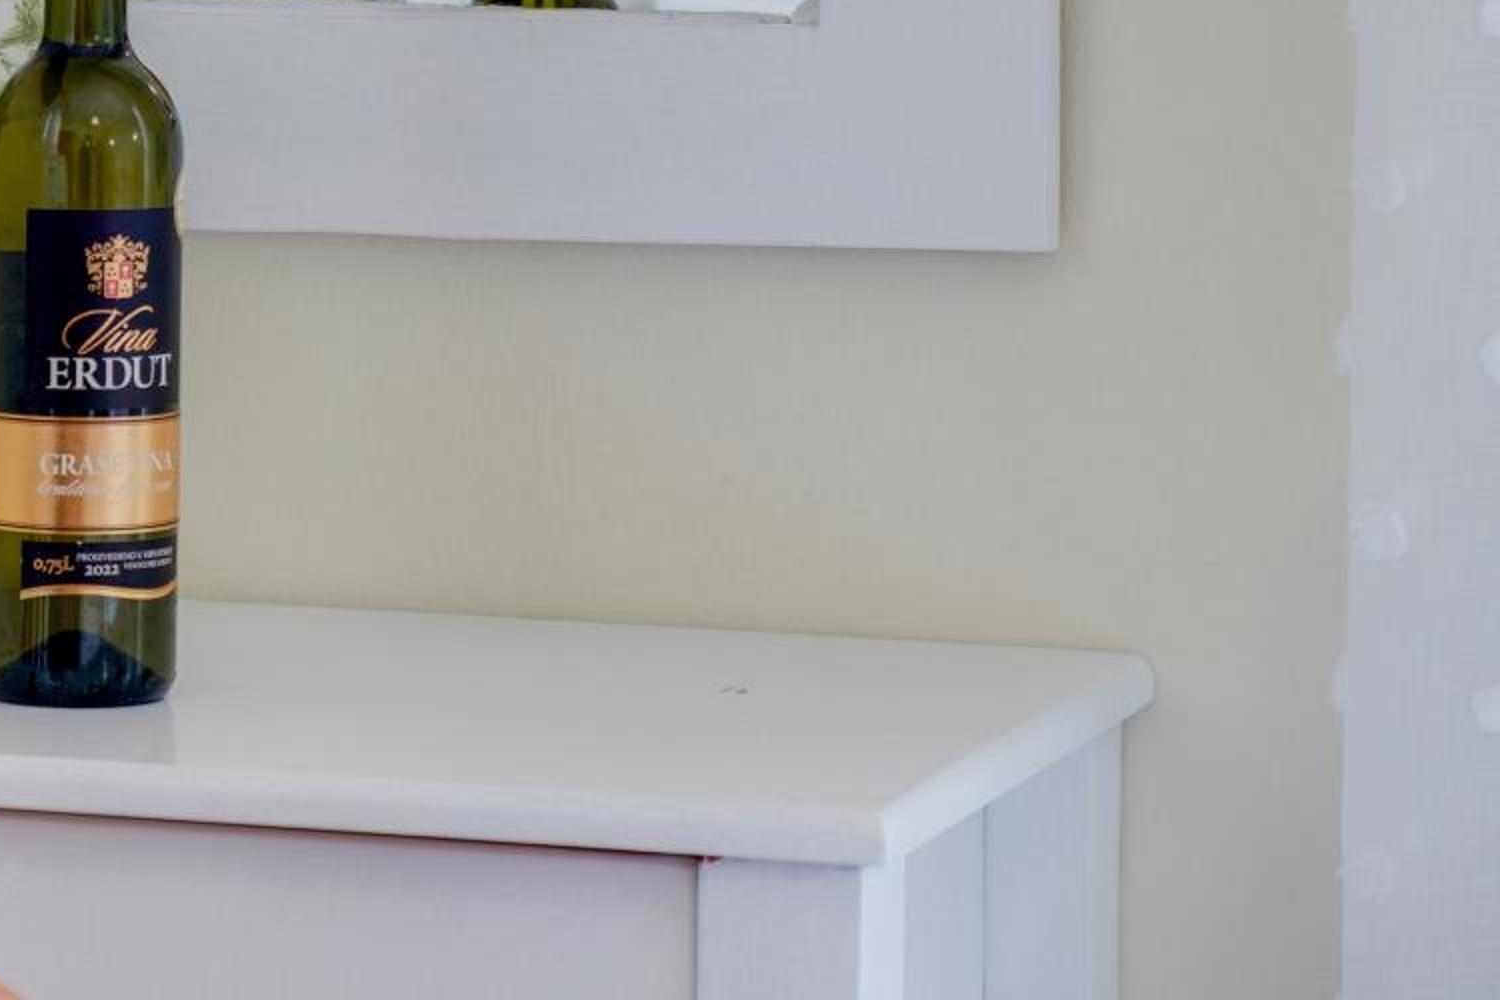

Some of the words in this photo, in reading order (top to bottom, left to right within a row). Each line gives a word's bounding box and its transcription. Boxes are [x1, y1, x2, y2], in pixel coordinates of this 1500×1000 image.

[62, 305, 158, 354] Vina
[46, 353, 172, 390] ERDUT
[38, 449, 173, 476] GRANA
[84, 564, 120, 576] 2022
